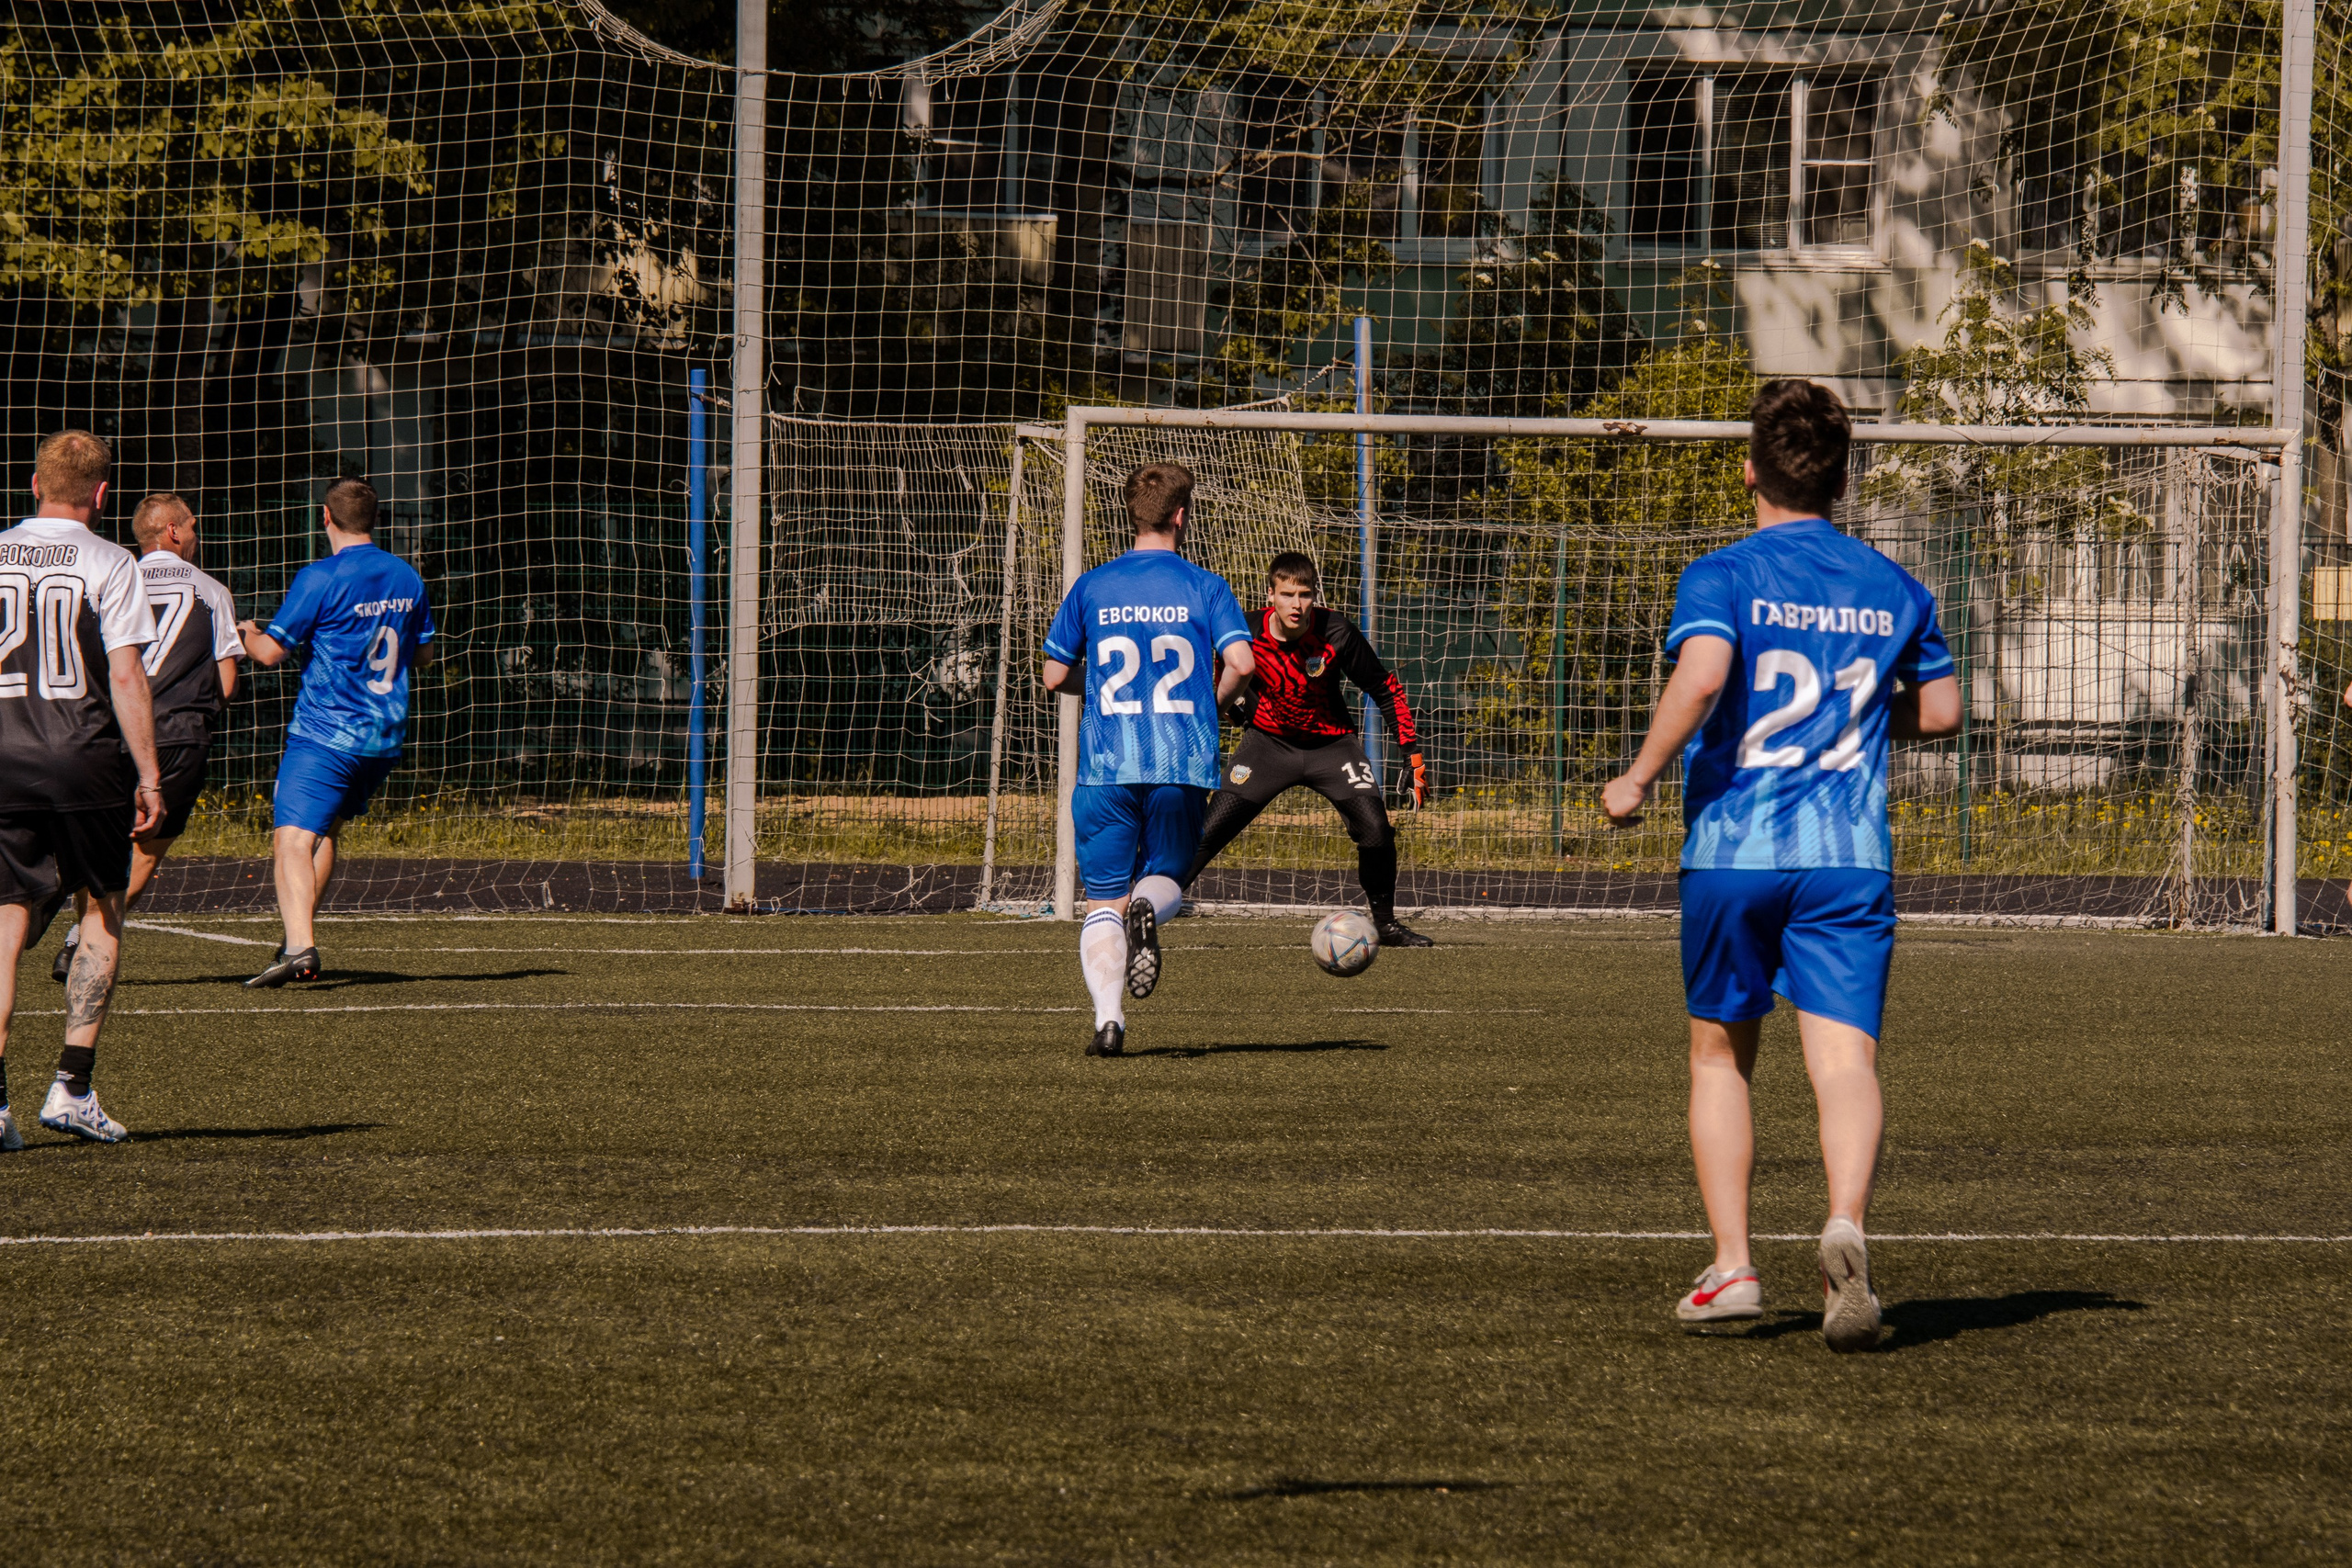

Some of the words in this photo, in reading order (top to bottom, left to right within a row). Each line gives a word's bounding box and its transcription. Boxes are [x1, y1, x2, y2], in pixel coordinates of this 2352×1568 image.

[0, 544, 78, 568] СОКОЛОВ
[0, 572, 87, 700] 20
[1098, 605, 1189, 626] ЕВСЮКОВ
[1751, 599, 1894, 637] ГАВРИЛОВ
[367, 626, 399, 694] 9
[1097, 634, 1194, 716] 22
[1736, 649, 1877, 772] 21
[1341, 761, 1375, 784] 13
